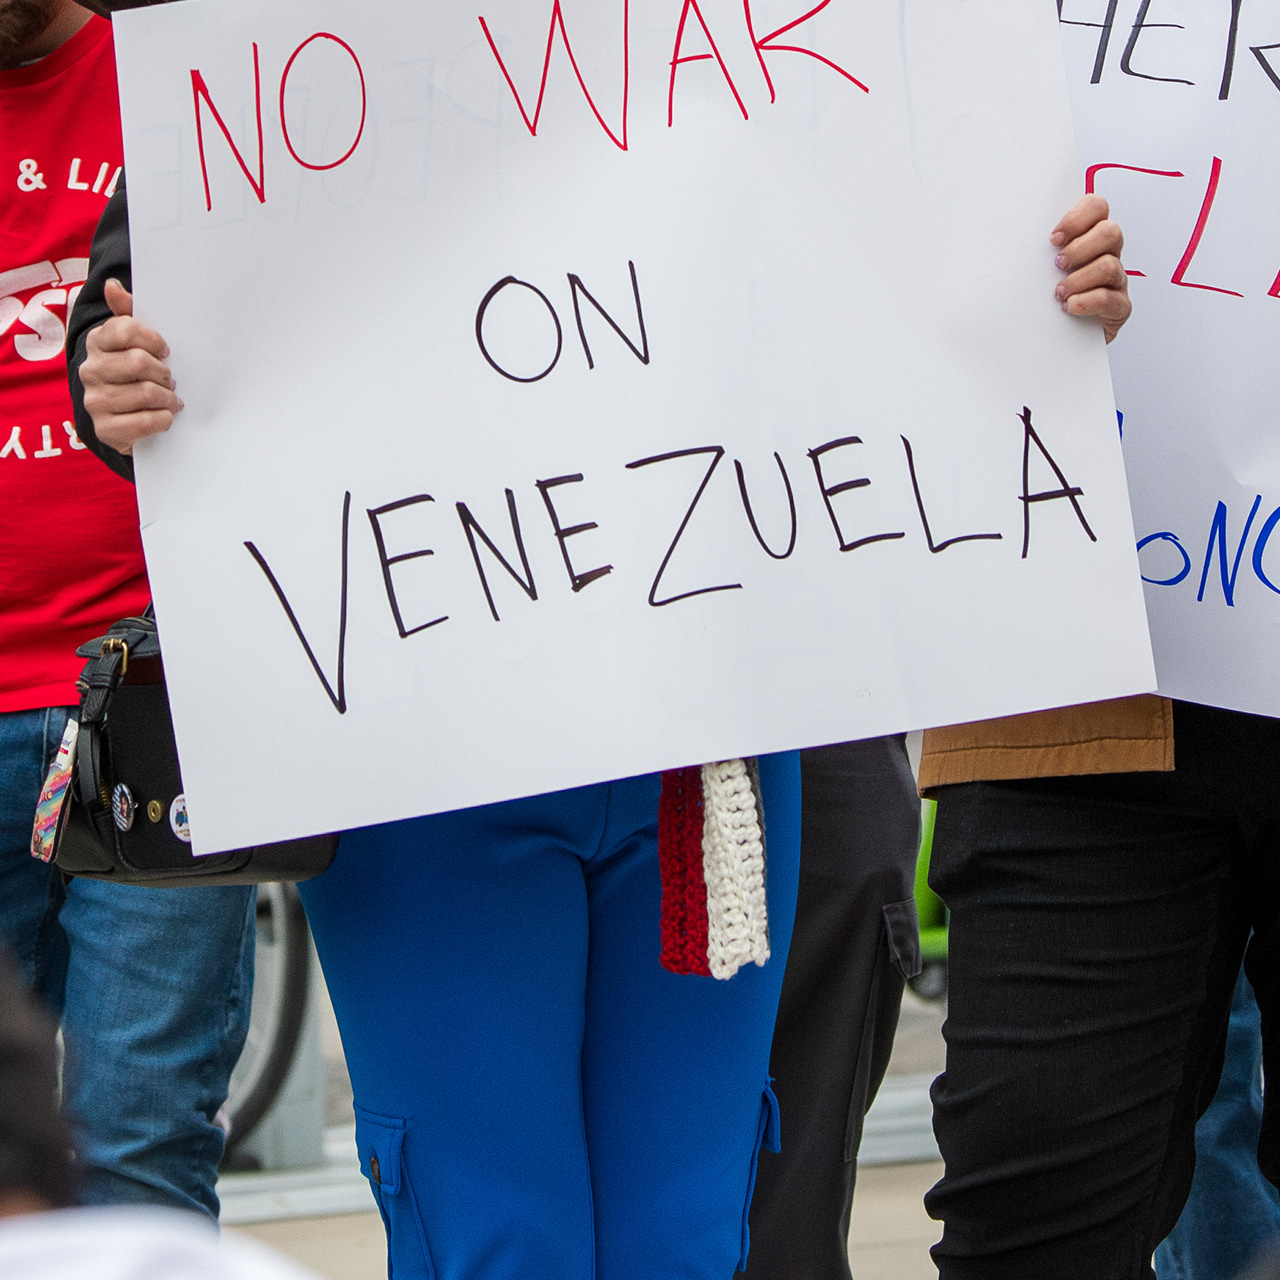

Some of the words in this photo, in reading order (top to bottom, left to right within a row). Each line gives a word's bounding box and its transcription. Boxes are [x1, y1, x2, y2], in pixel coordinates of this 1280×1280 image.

[17, 158, 47, 192] &
[190, 32, 366, 211] NO
[475, 260, 650, 383] ON
[243, 406, 1096, 715] VENEZUELA
